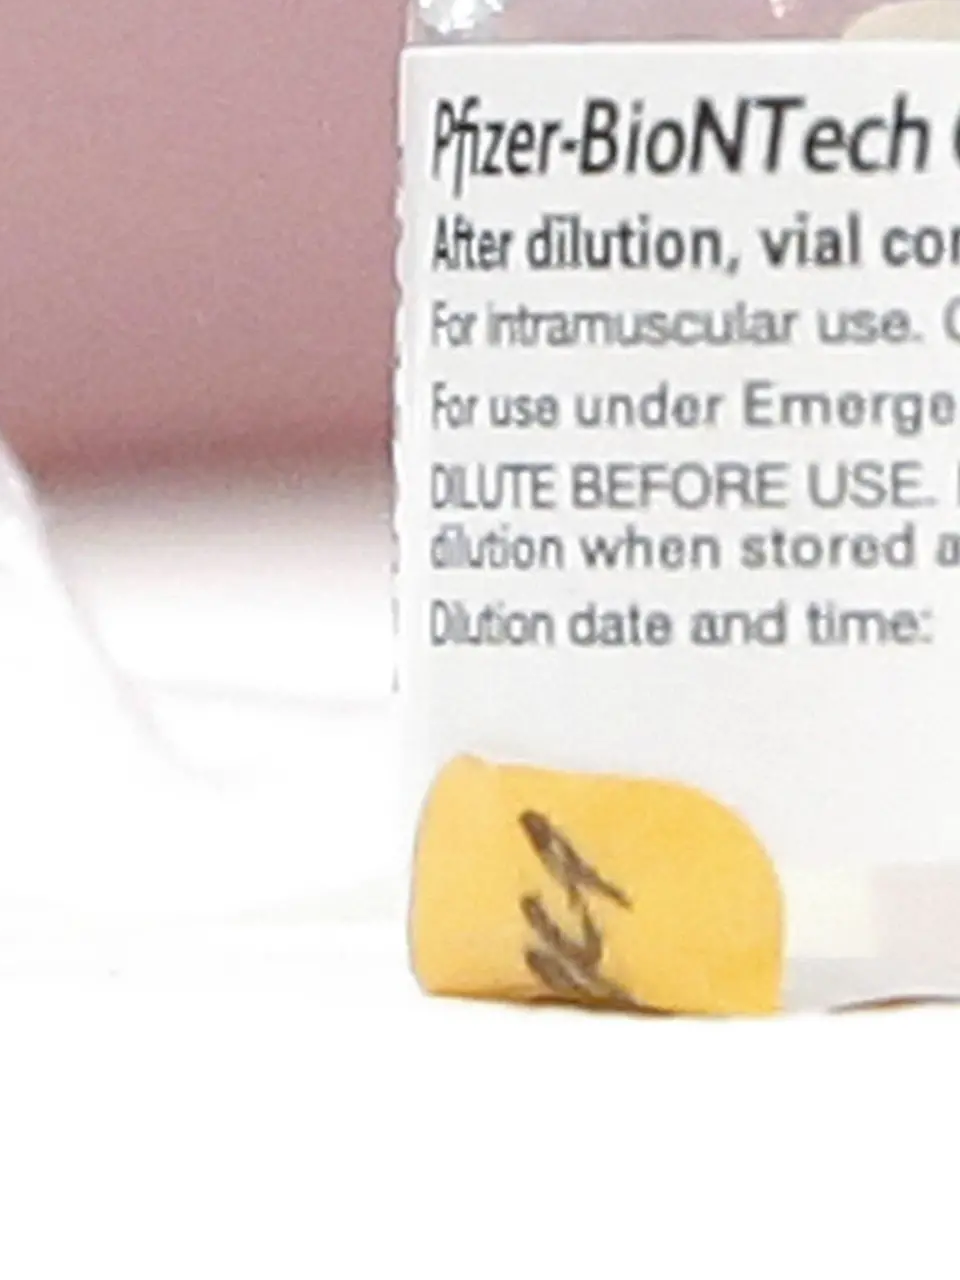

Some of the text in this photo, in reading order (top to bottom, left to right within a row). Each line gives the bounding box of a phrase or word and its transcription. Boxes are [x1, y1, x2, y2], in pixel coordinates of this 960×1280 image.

[432, 92, 932, 198] Pfizer-BioNTech
[431, 213, 515, 271] After
[526, 212, 740, 276] dilution,
[759, 210, 861, 269] vial
[431, 299, 478, 348] For
[486, 300, 800, 348] intramuscular
[818, 309, 926, 346] use.
[431, 380, 479, 430] For
[489, 393, 560, 429] use
[574, 380, 725, 429] under
[430, 460, 937, 511] DILUTE BEFORE USE.
[430, 523, 565, 571] dilution
[579, 523, 721, 571] when
[740, 521, 915, 570] stored
[430, 598, 934, 648] Dilution date and time:
